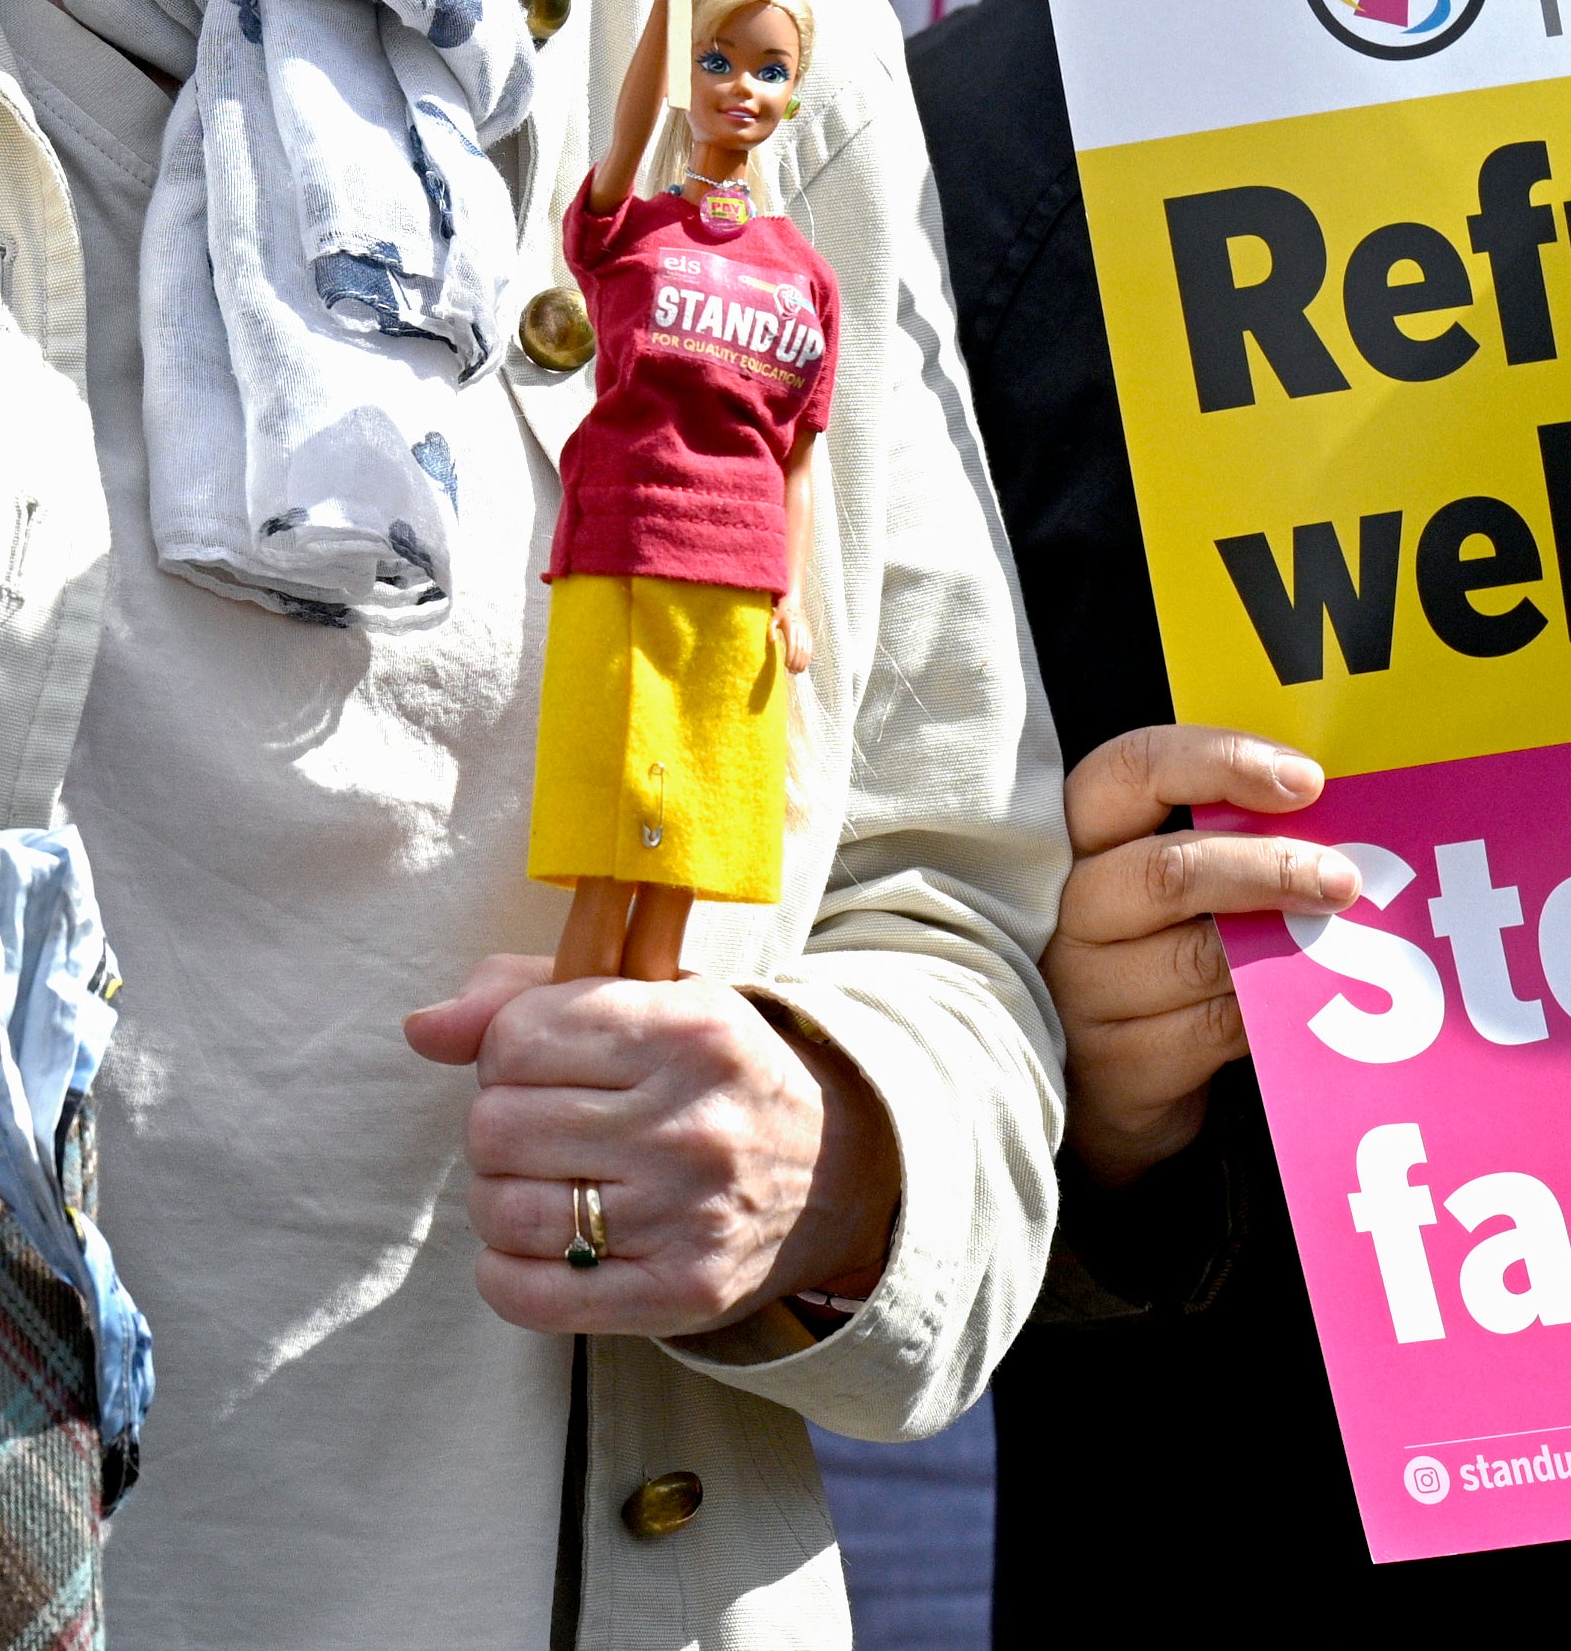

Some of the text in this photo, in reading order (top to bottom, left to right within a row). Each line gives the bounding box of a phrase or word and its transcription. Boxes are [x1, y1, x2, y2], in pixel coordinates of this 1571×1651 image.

[663, 255, 702, 275] eis
[655, 285, 825, 369] STAND UP
[651, 331, 680, 348] FOR
[683, 337, 738, 364] QUALITY
